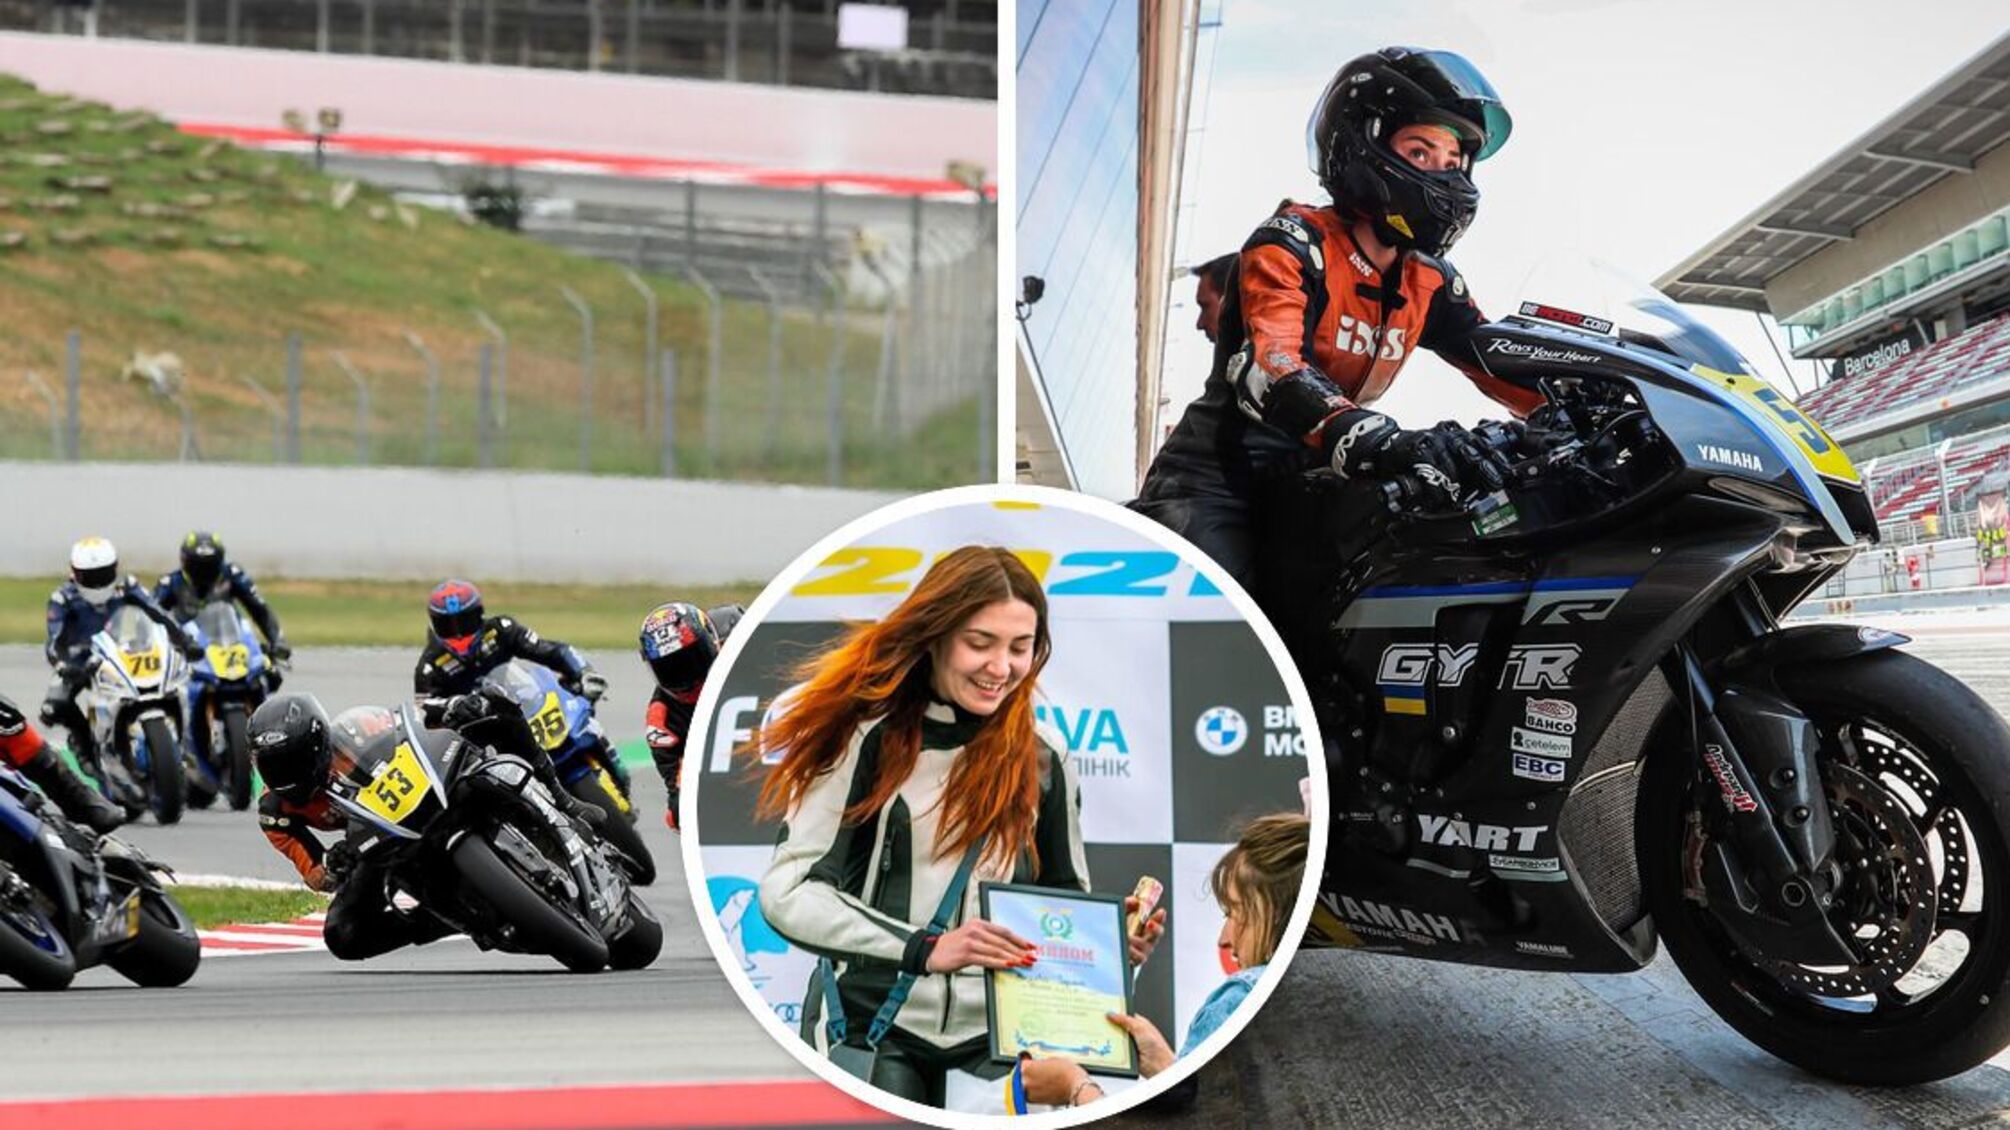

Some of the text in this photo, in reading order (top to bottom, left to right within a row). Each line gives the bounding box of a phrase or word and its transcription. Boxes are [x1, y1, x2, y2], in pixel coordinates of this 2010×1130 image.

[1487, 338, 1602, 363] Revs Your Heart
[1844, 337, 1911, 376] Barcelona
[1698, 444, 1763, 473] YAMAHA
[129, 656, 161, 676] 70
[1527, 715, 1574, 733] BAHCO
[1515, 756, 1563, 775] EBC
[376, 767, 415, 812] 53
[1418, 814, 1549, 852] YART
